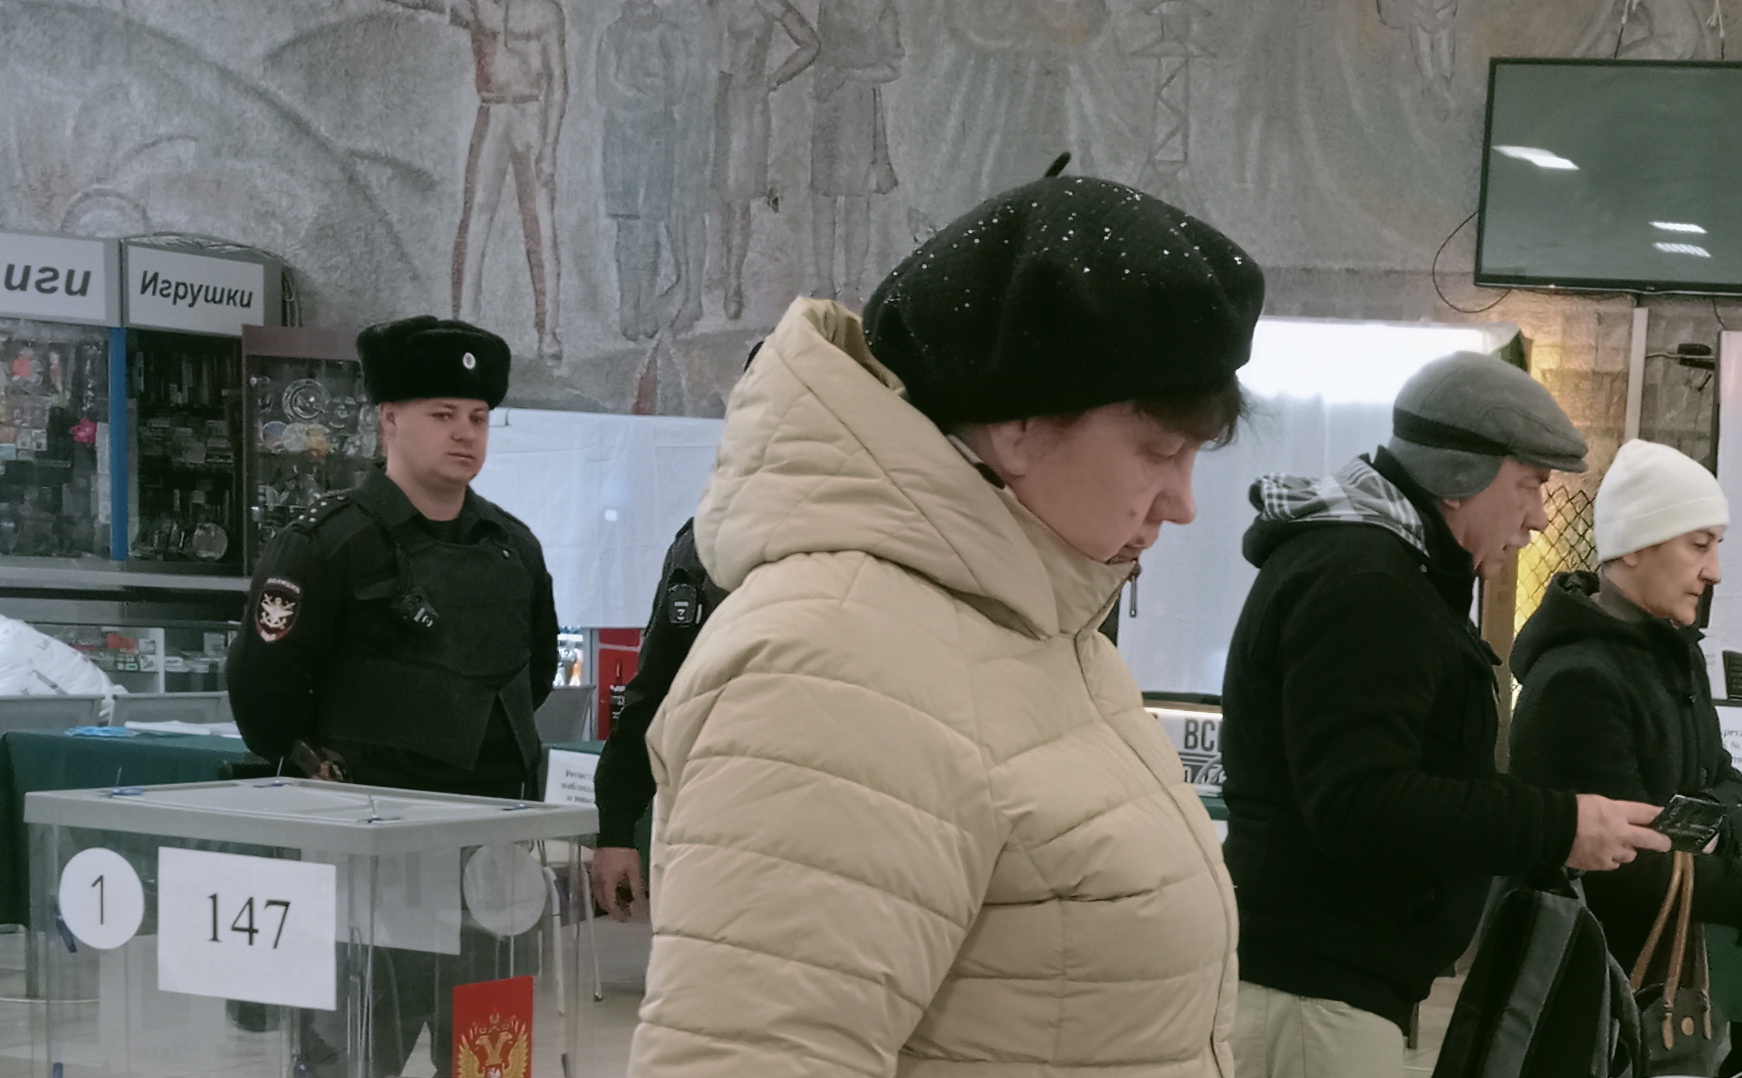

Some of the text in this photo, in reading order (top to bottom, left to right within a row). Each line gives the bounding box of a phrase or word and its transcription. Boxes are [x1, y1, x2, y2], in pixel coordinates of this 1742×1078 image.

[140, 270, 253, 308] Игрушки
[91, 874, 105, 925] 1
[207, 892, 291, 949] 147
